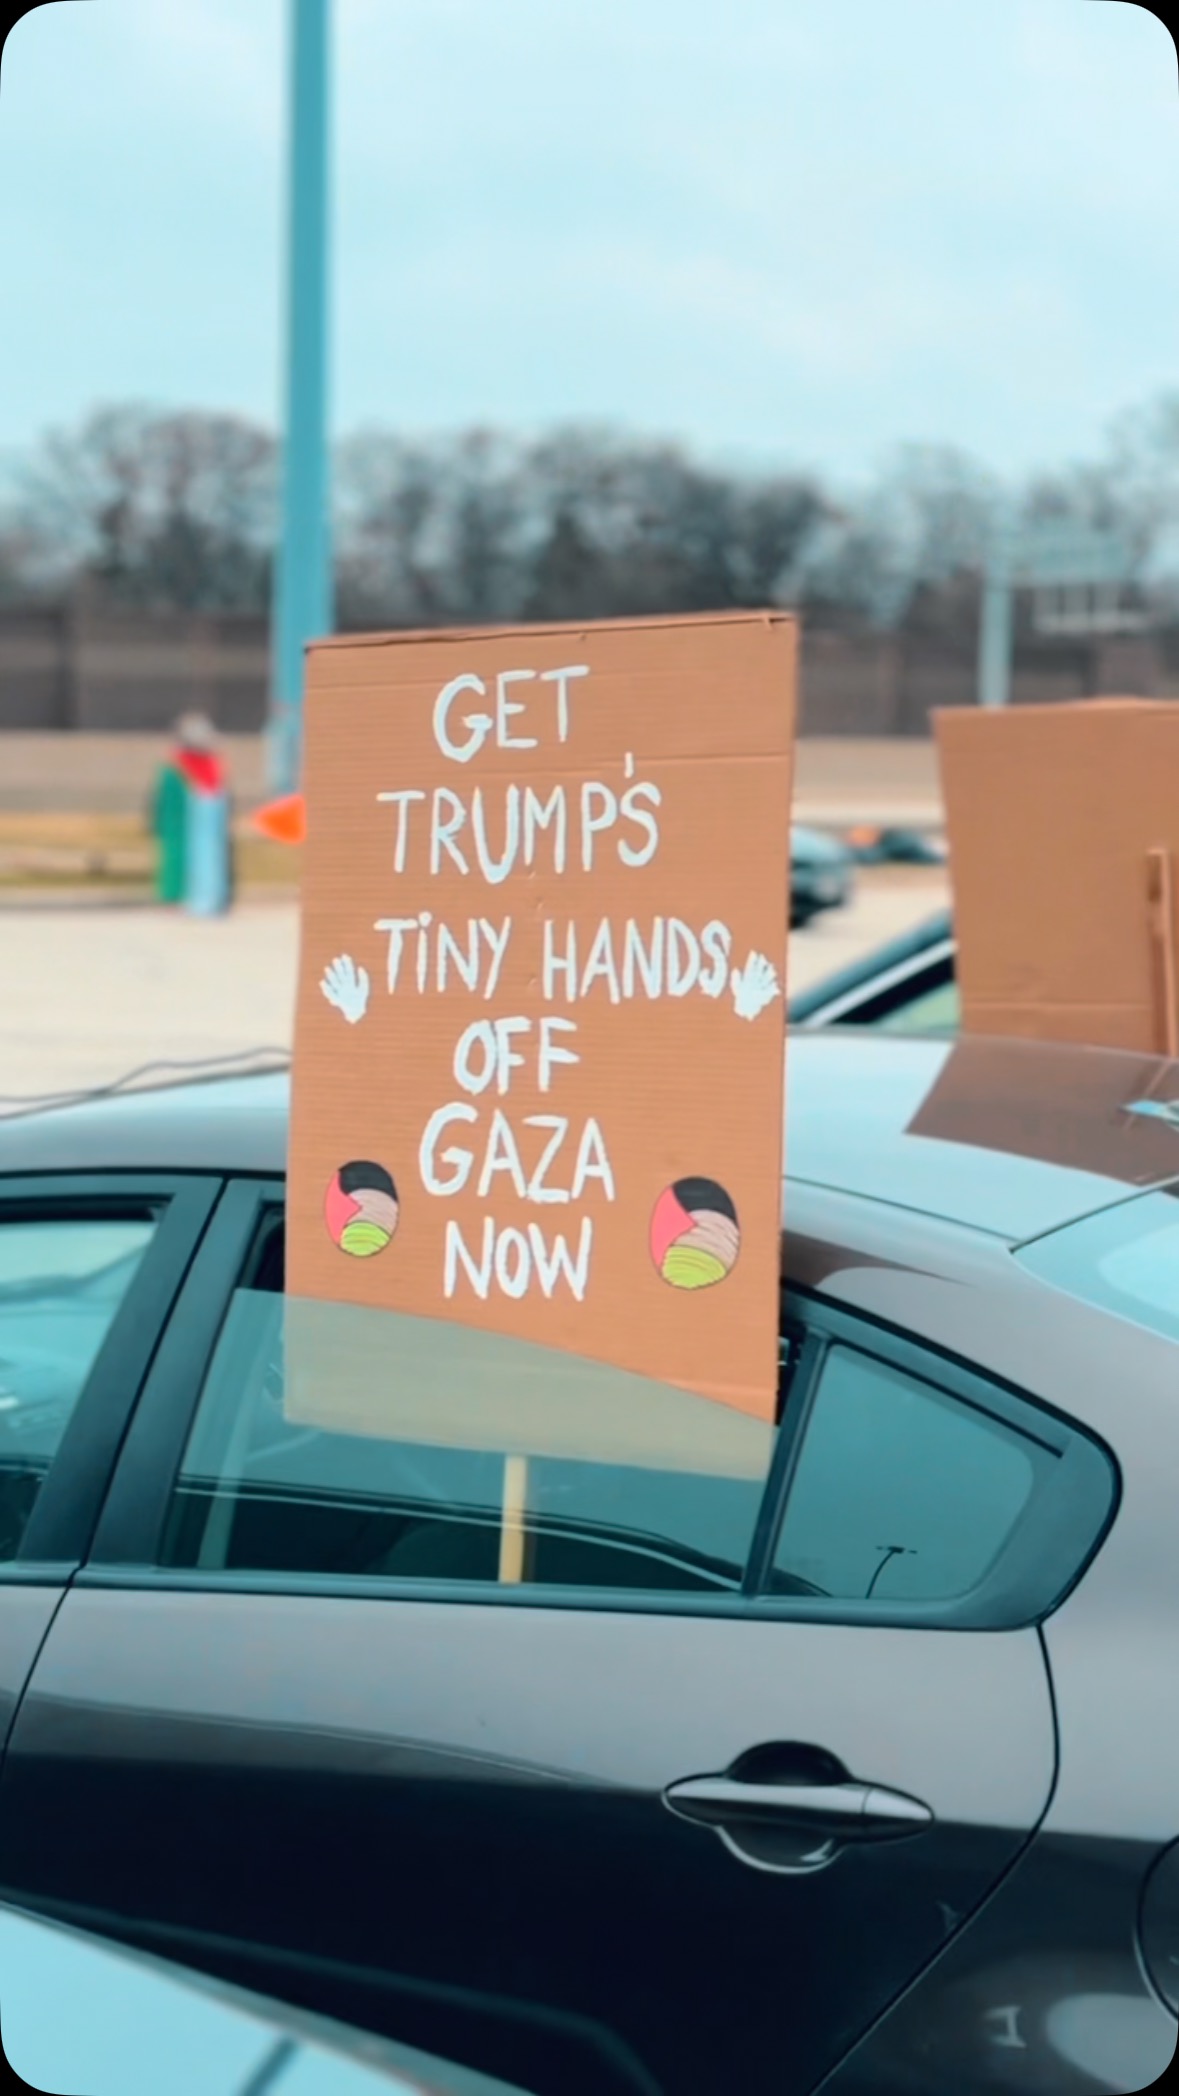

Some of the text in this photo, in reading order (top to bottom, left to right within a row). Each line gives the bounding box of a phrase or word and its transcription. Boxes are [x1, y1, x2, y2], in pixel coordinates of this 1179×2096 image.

[432, 665, 590, 763] GET
[376, 751, 662, 884] TRUMP'S
[542, 916, 733, 1005] HANDS
[453, 1015, 581, 1096] OFF
[418, 1101, 616, 1204] GAZA
[443, 1216, 593, 1302] NOW
